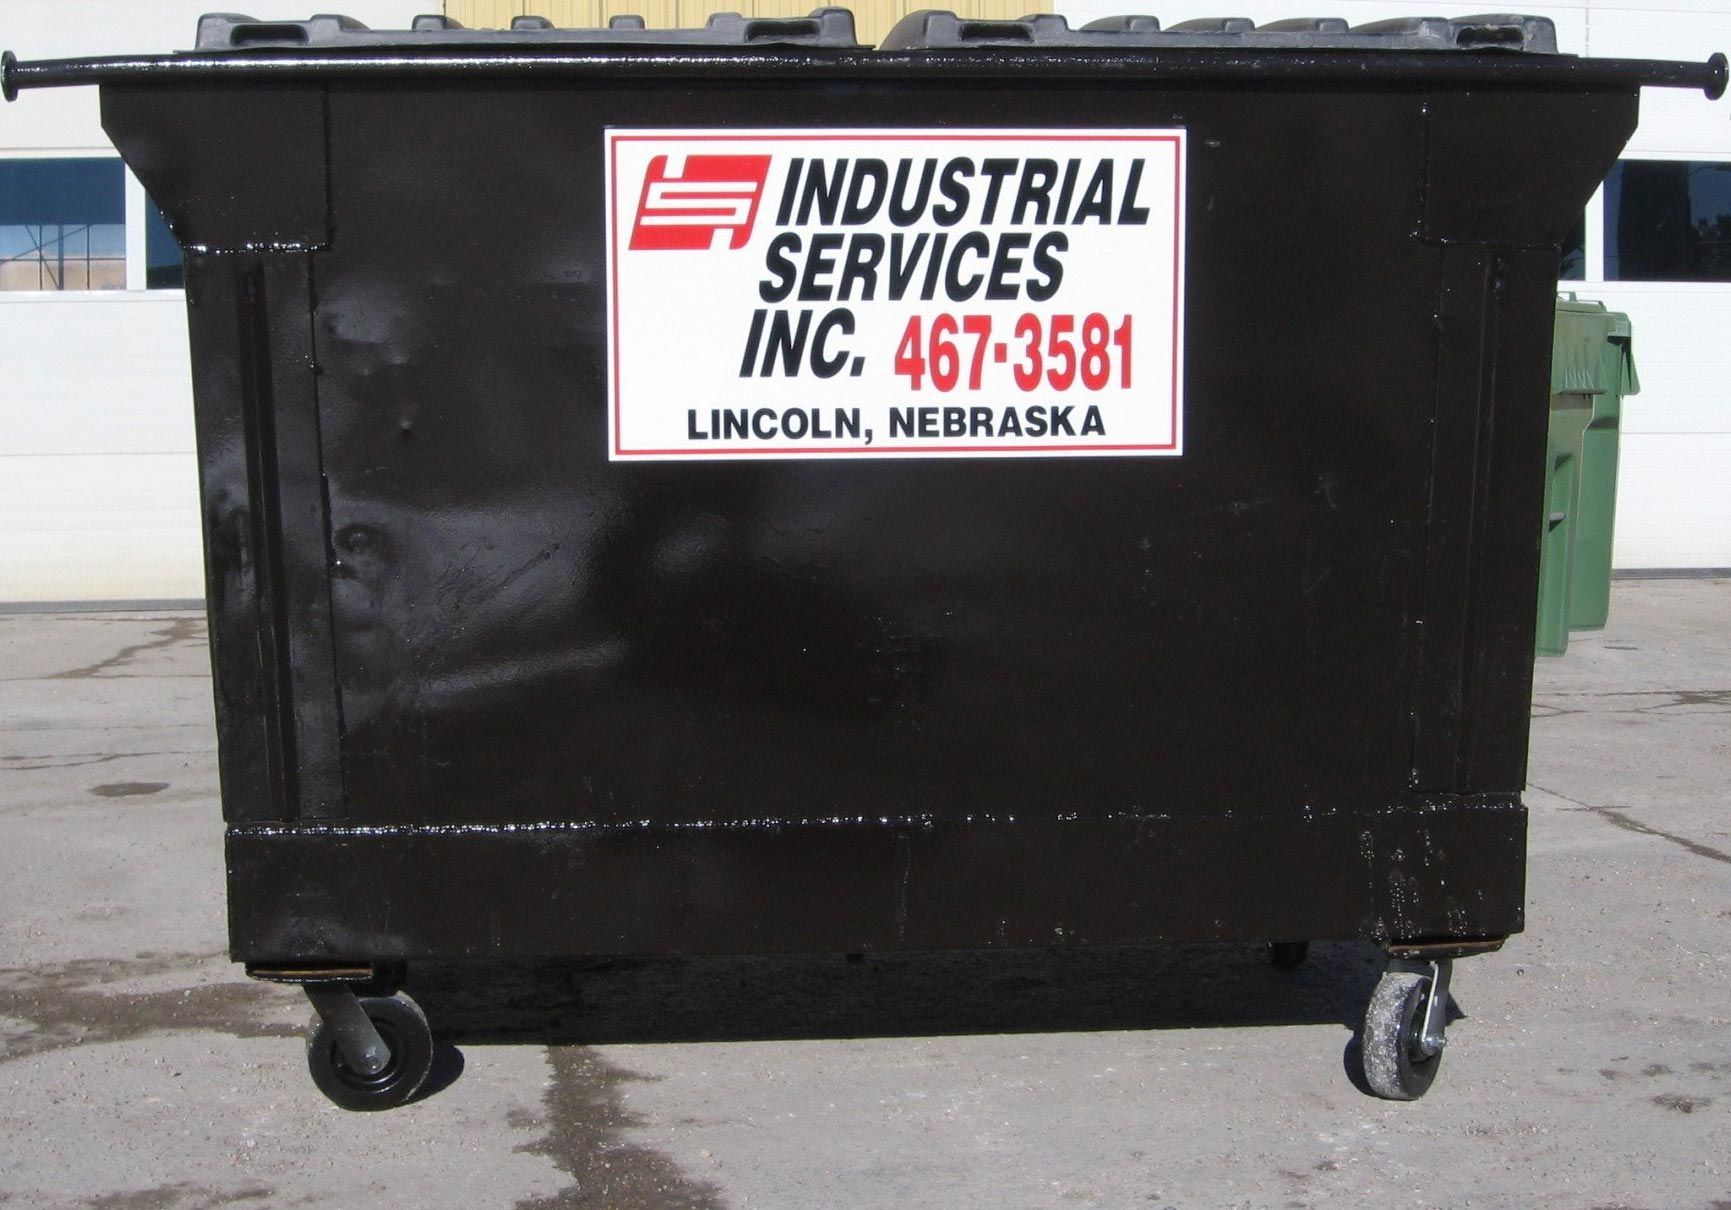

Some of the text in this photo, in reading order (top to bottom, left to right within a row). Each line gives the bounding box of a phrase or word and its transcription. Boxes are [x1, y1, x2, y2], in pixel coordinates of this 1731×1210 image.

[775, 156, 1150, 227] INDUSTRIAL
[758, 230, 1069, 303] SERVICES
[739, 308, 1133, 392] INC. 467-3581
[687, 405, 1106, 445] LINCOLN, NEBRASKA
